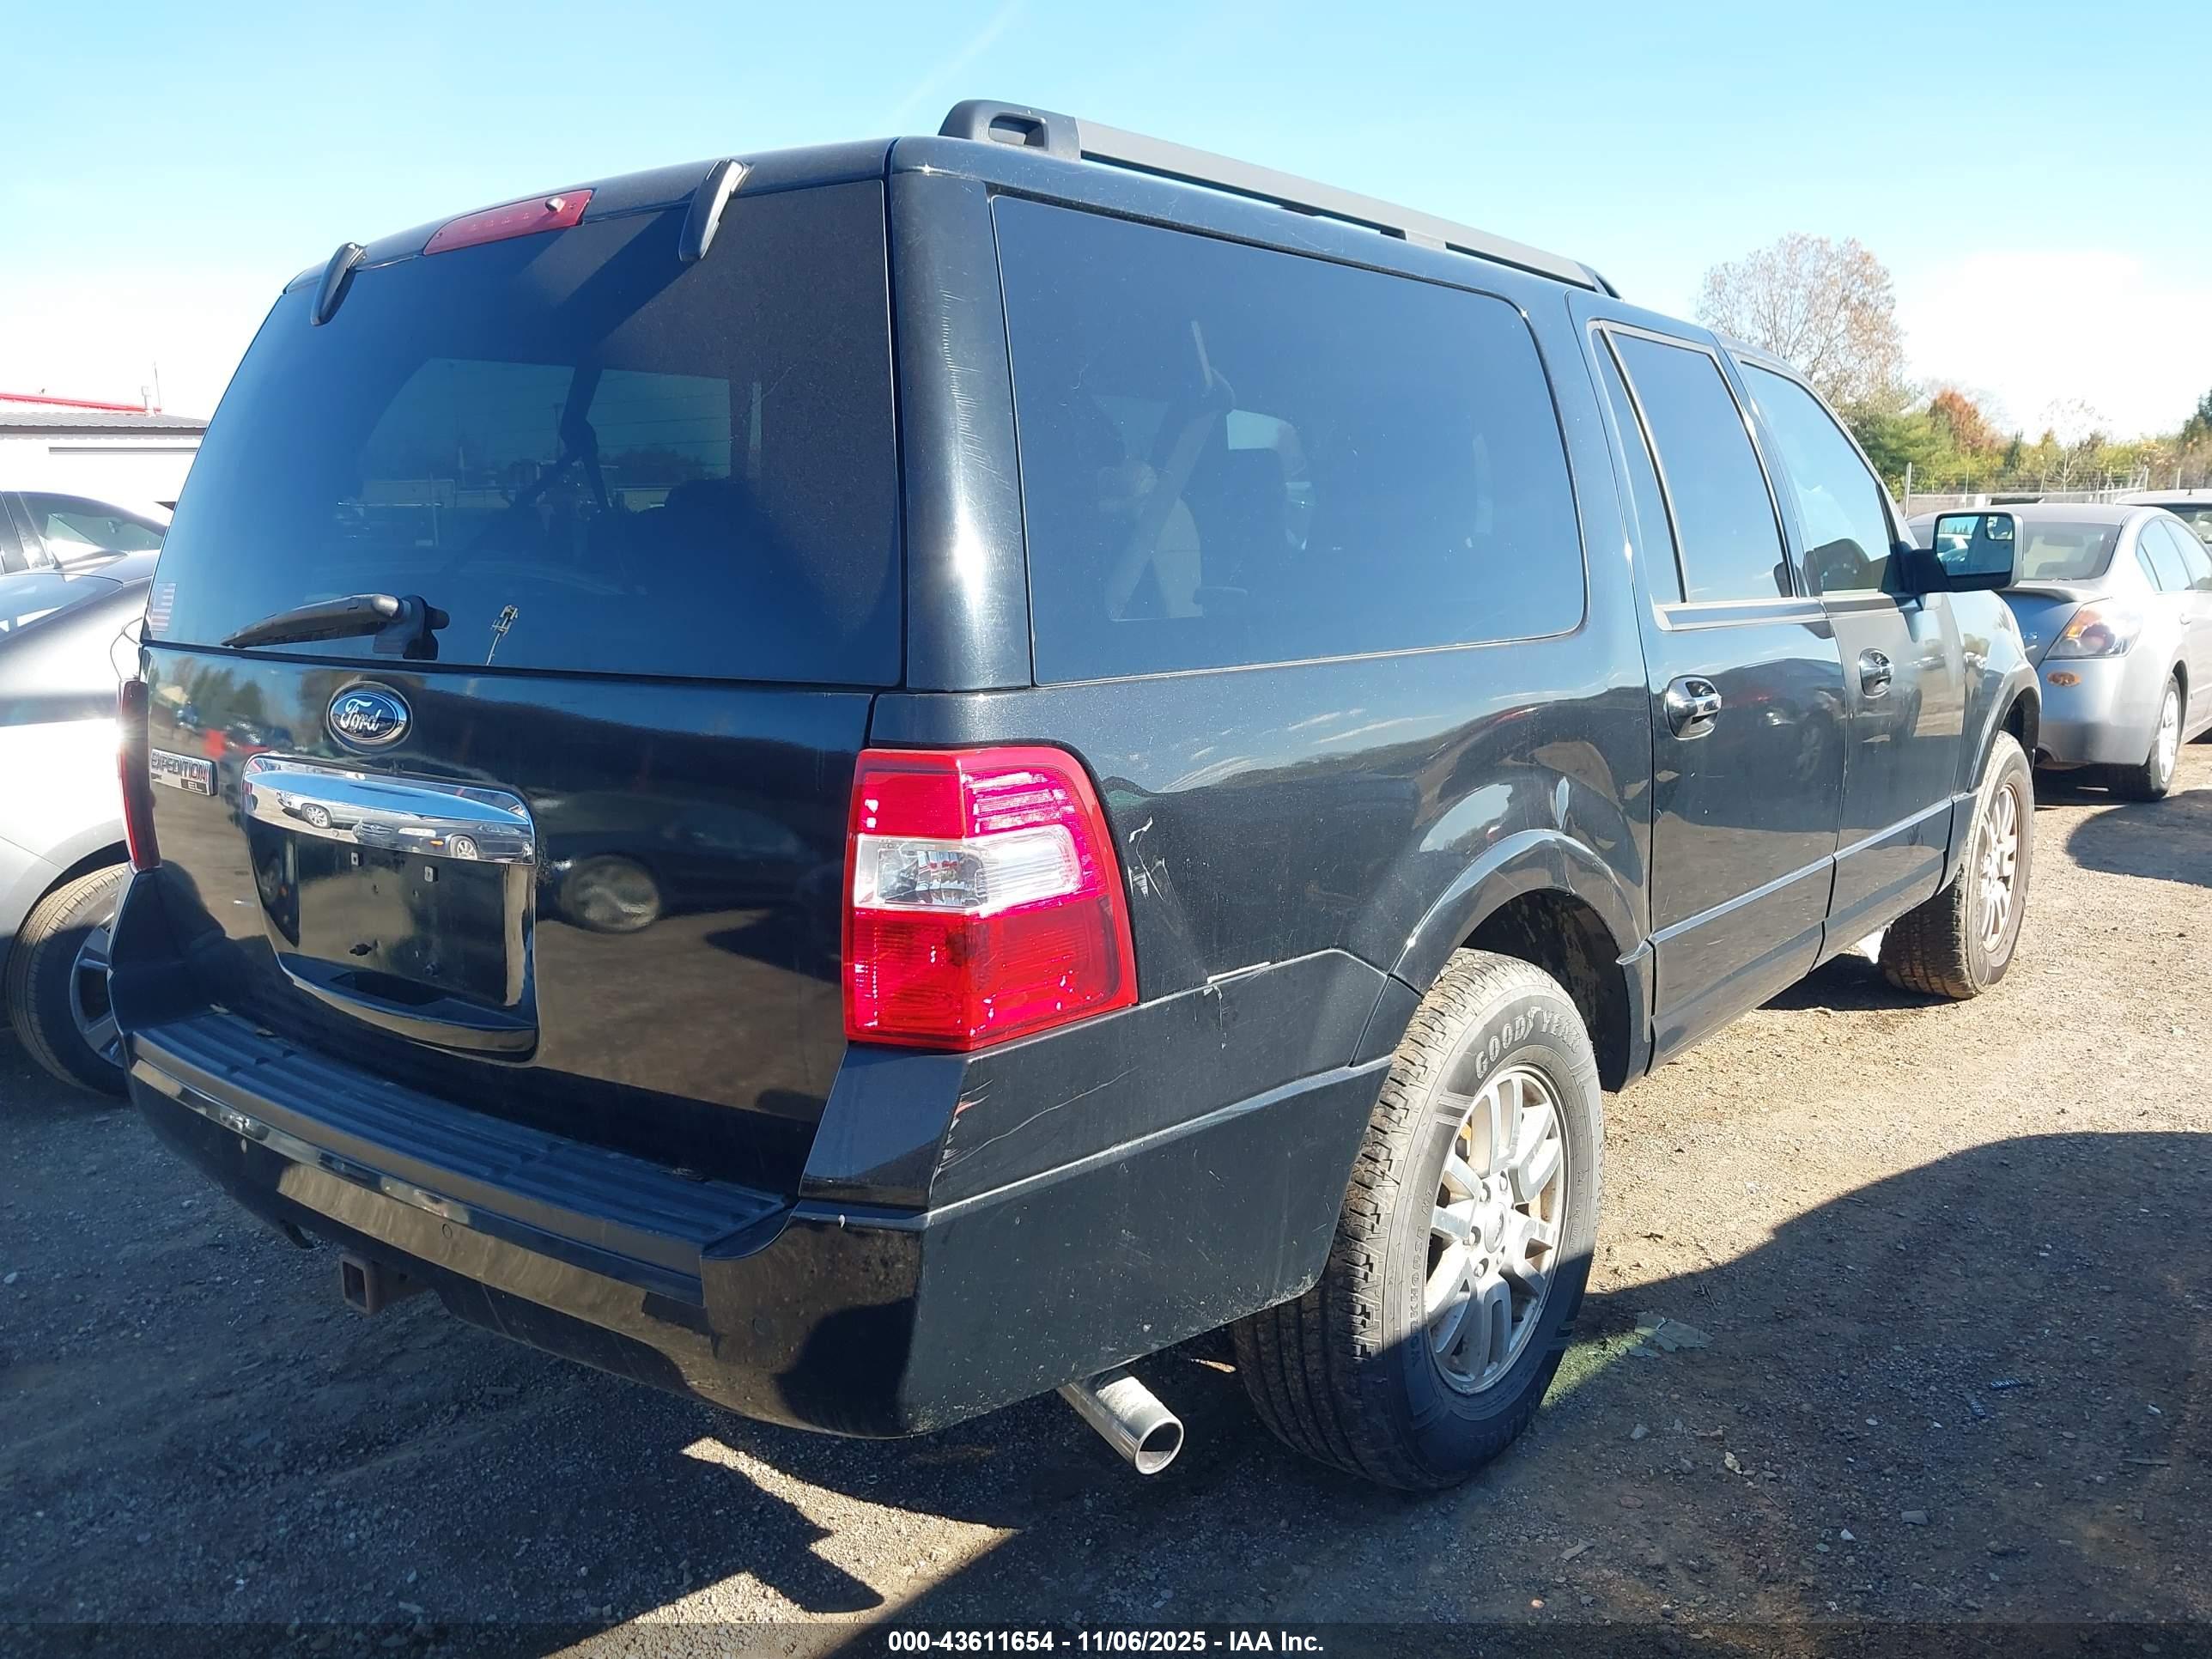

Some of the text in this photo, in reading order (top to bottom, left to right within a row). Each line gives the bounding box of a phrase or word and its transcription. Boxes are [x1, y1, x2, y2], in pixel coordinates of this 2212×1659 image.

[339, 698, 383, 734] Ford
[187, 781, 204, 793] EL
[1474, 1006, 1582, 1080] GOODYEAR
